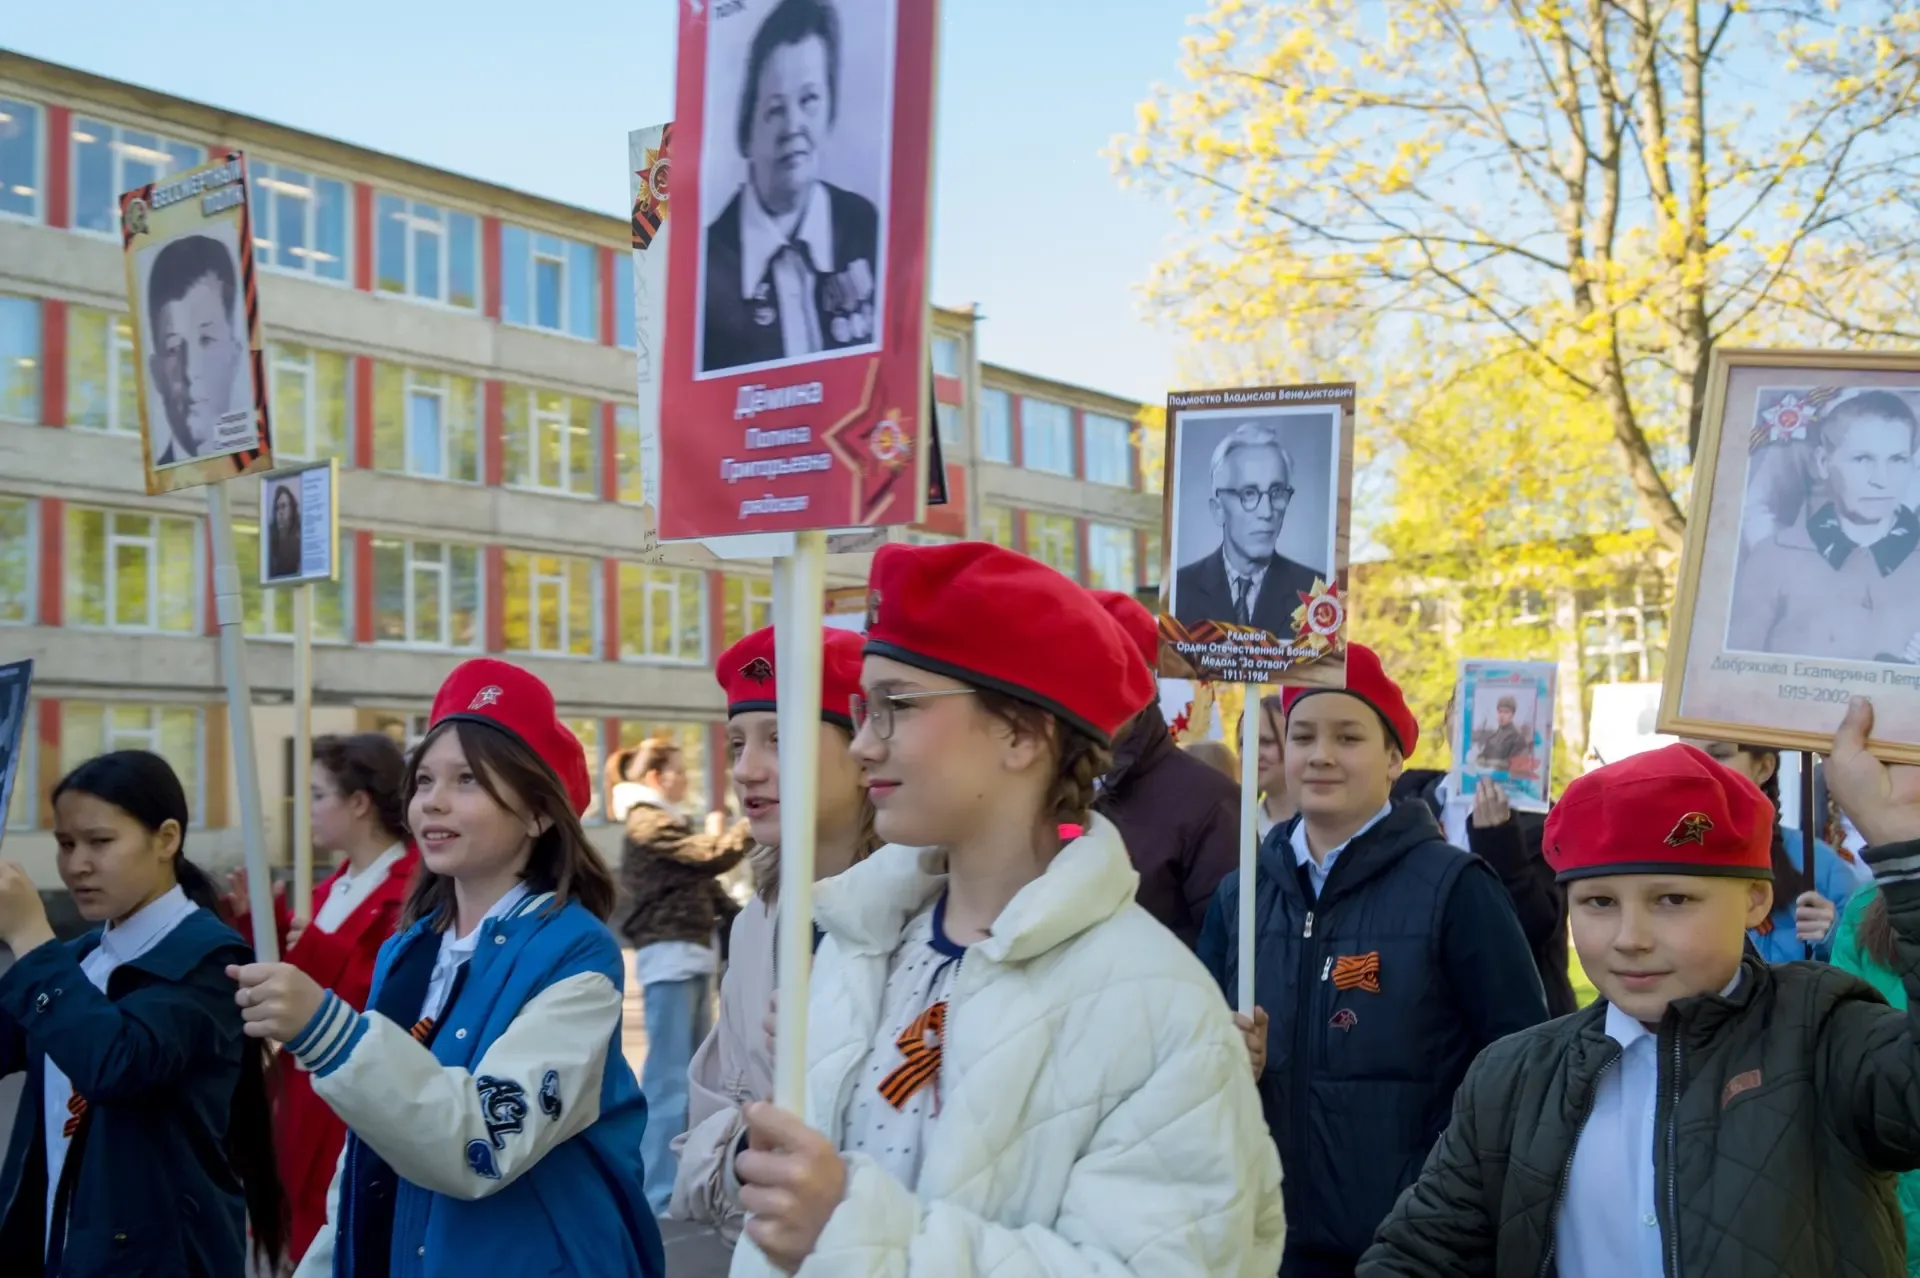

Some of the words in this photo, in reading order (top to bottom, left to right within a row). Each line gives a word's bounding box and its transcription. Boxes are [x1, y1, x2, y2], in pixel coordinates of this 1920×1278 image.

[734, 382, 823, 420] Дёмина
[1169, 394, 1221, 406] Подмостко
[1223, 391, 1276, 404] Владислав
[1279, 387, 1353, 401] Венедиктович
[745, 426, 811, 449] Полина
[1227, 630, 1267, 641] Рядовой
[1177, 642, 1207, 653] Орден
[1209, 643, 1285, 656] Отечественной
[1201, 655, 1237, 667] Медаль
[1256, 658, 1294, 672] отвагу"
[1710, 656, 1788, 674] Добрякова
[1793, 662, 1877, 683] Екатерина
[1223, 669, 1269, 682] 1911-1984
[1778, 684, 1849, 704] 1919-2002
